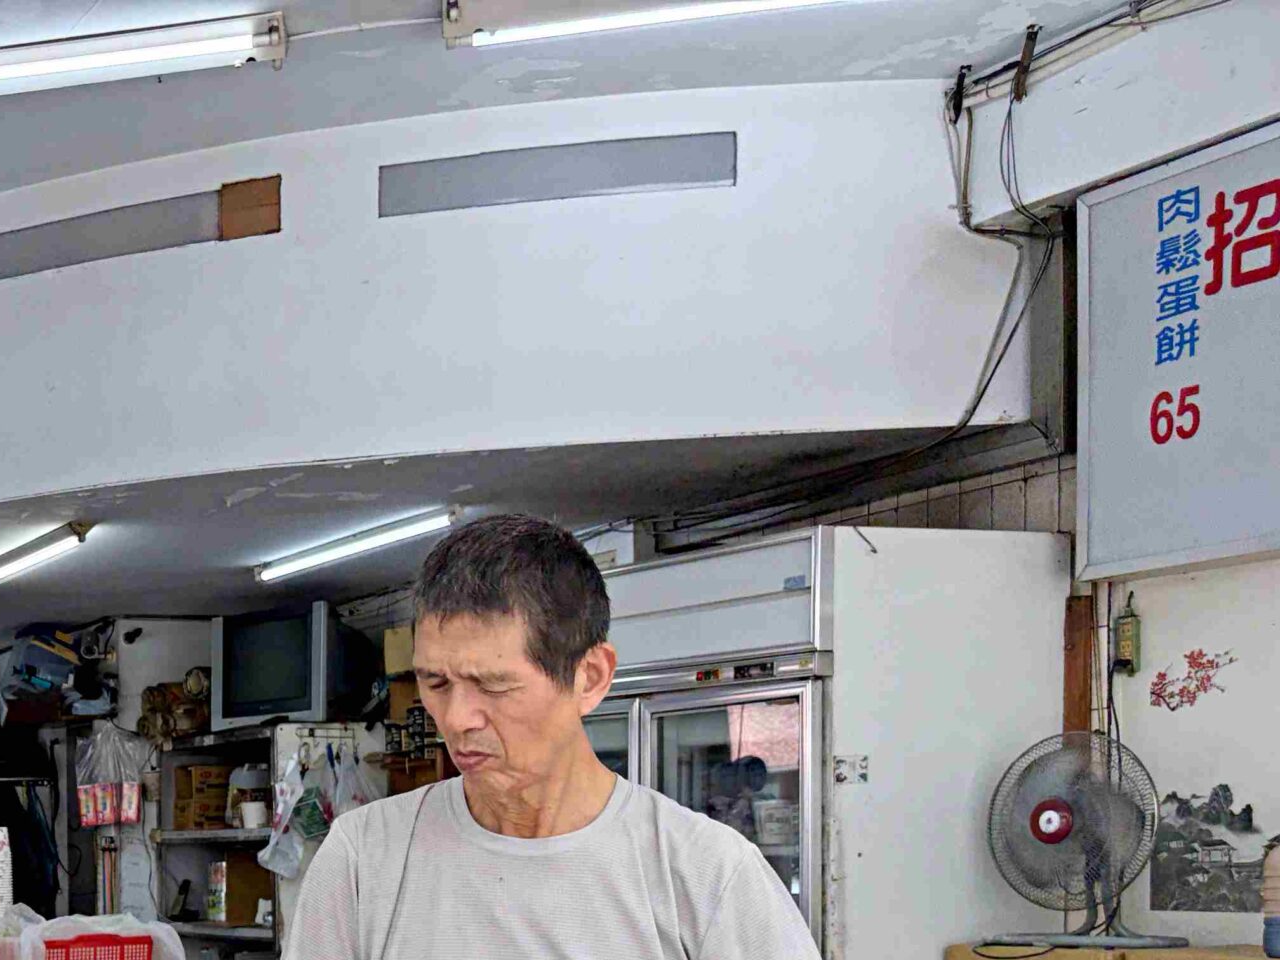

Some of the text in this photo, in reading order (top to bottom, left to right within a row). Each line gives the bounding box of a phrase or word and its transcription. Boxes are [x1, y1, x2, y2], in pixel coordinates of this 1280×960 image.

[1154, 185, 1201, 367] 肉鬆蛋餅
[1204, 179, 1280, 296] 招
[1149, 384, 1201, 445] 65
